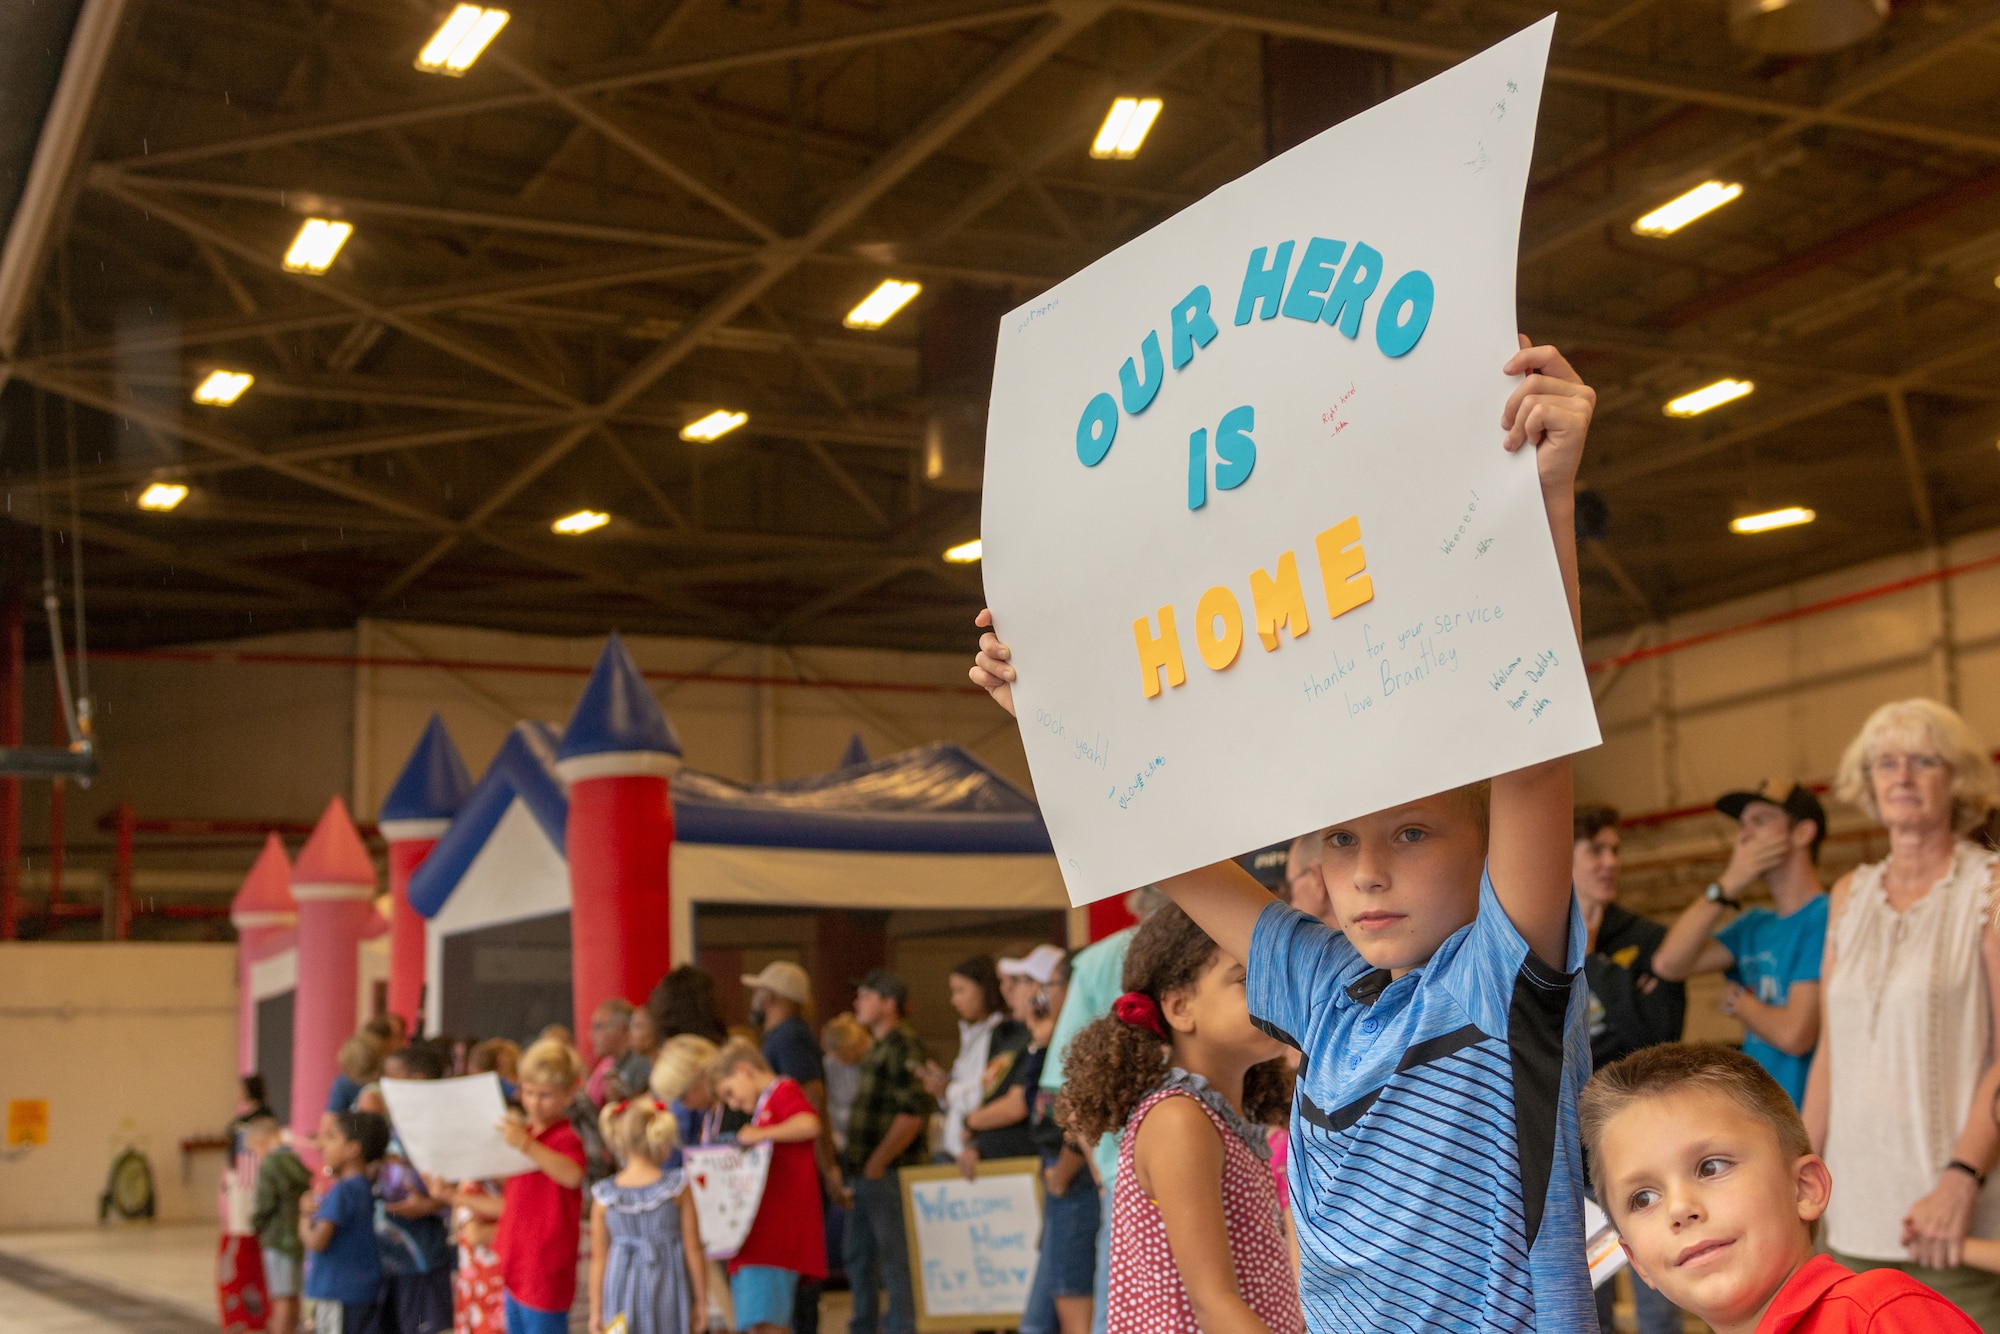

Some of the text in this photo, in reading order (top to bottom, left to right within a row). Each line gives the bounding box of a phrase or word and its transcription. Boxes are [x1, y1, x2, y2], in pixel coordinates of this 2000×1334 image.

[1077, 238, 1434, 467] OUR HERO
[1189, 406, 1256, 510] IS
[1133, 516, 1375, 699] HOME
[1363, 623, 1385, 659] for
[1397, 621, 1424, 650] your
[1434, 600, 1505, 635] service
[1344, 637, 1459, 719] love Brantley
[1488, 657, 1522, 691] Welcome
[1506, 649, 1559, 711] Home Daddy
